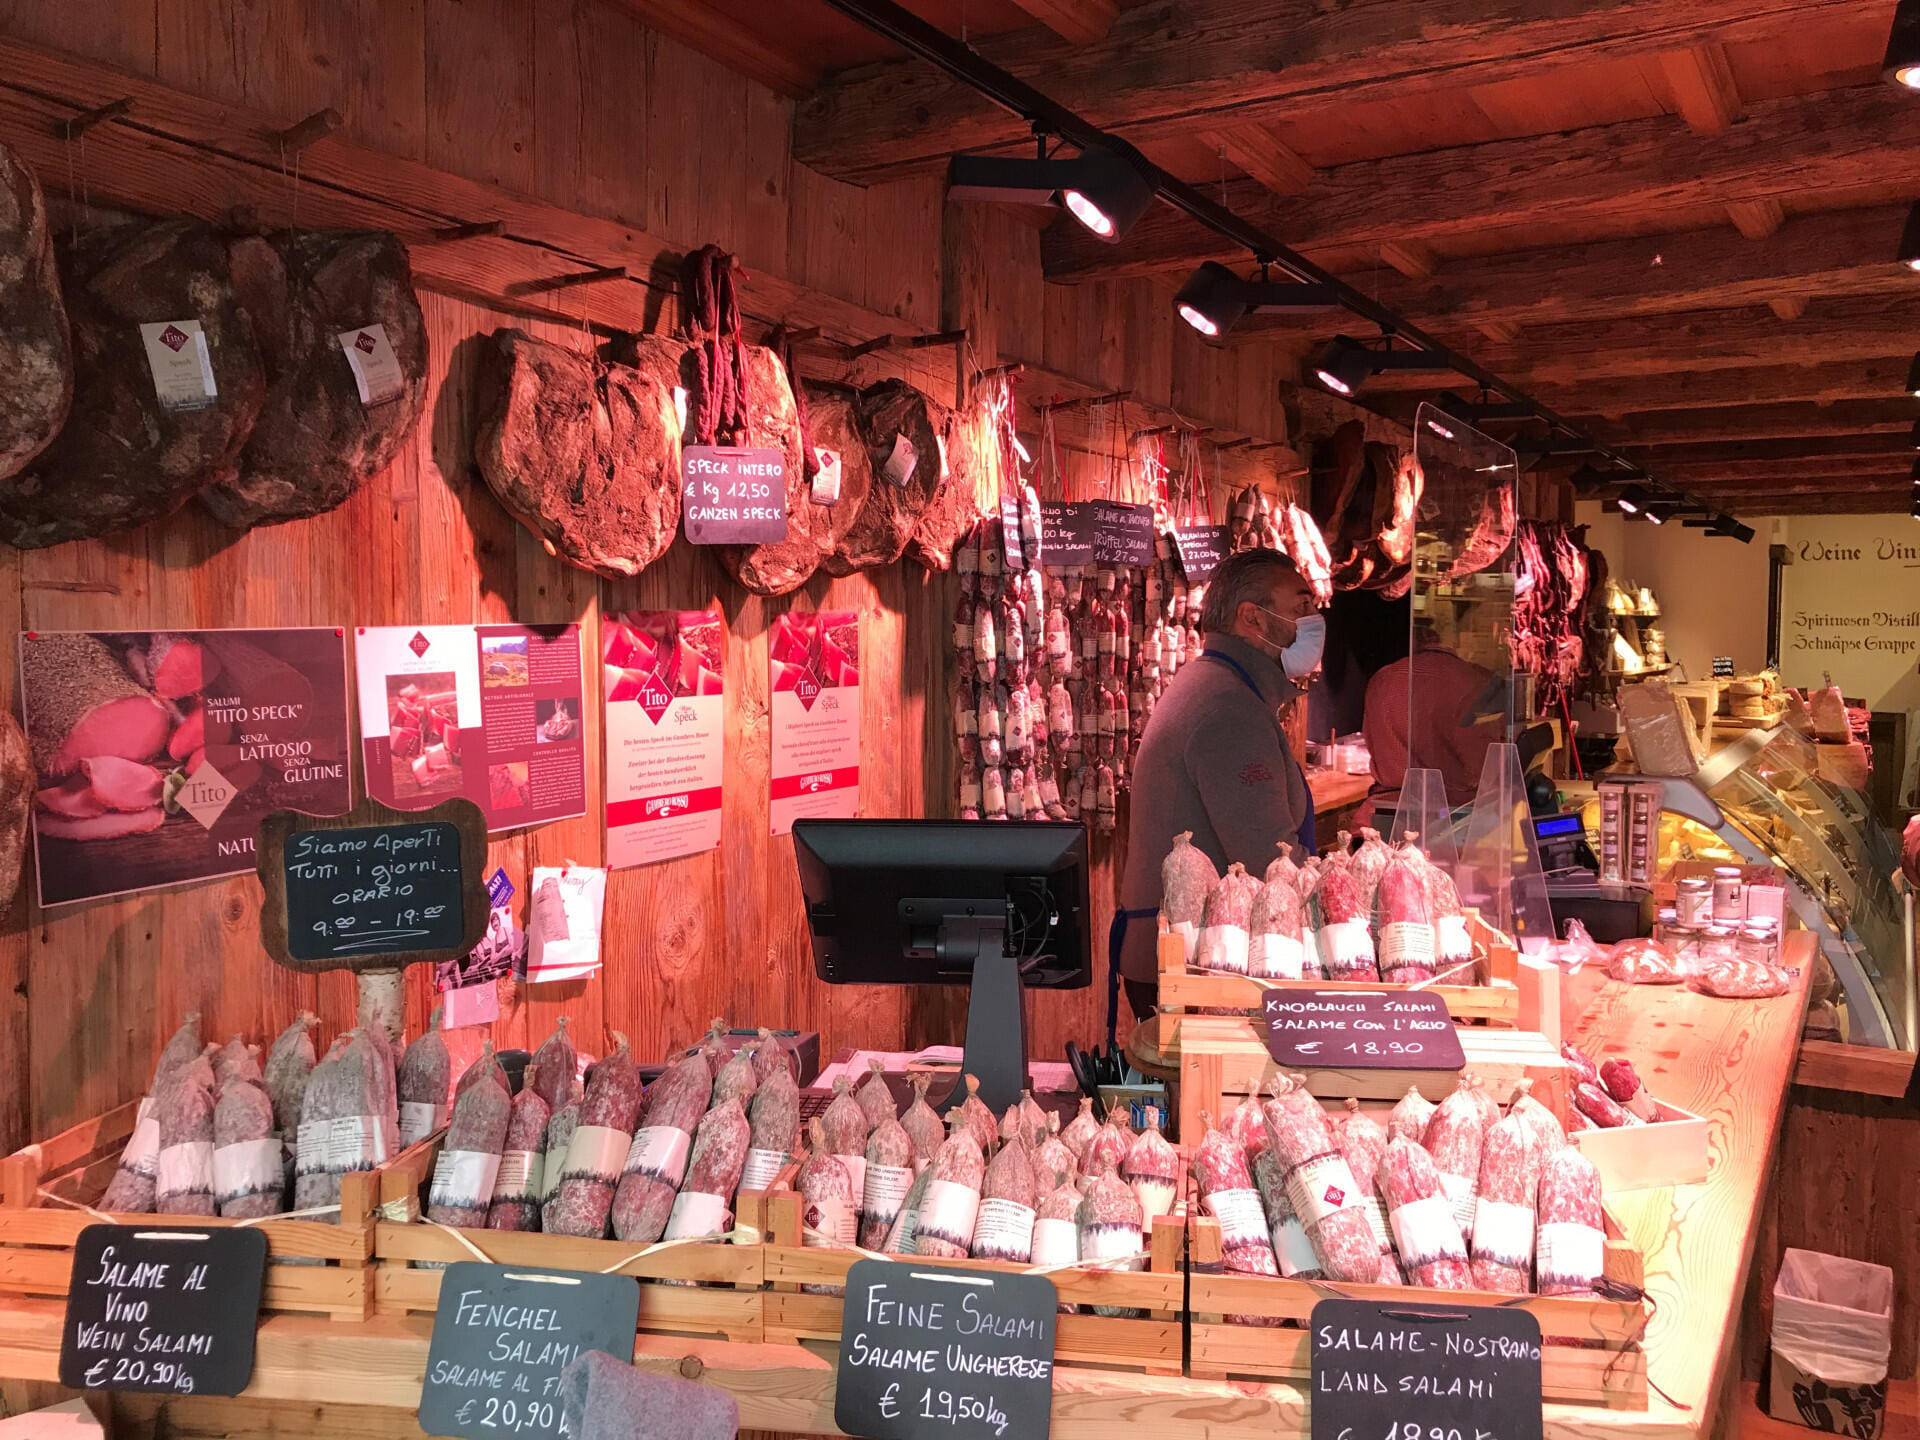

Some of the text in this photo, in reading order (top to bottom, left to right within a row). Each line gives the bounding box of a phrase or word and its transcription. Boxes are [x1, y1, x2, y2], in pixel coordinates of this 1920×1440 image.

[687, 460, 729, 474] SPECK
[684, 482, 696, 497] €
[727, 482, 770, 501] 12,50
[688, 506, 781, 521] GANZEN SPECK
[1797, 540, 1862, 562] Weine
[1792, 611, 1870, 630] Spirituosen
[1791, 633, 1916, 654] Schnäpse Grappe
[642, 688, 668, 706] Tito
[799, 680, 817, 696] Tito
[207, 697, 241, 708] SALUMI
[674, 709, 698, 725] Speck
[240, 733, 269, 744] SENZA
[239, 741, 312, 761] LATTOSIO
[283, 757, 311, 767] SENZA
[284, 764, 344, 783] GLUTINE
[187, 782, 226, 804] Tito
[294, 835, 367, 858] Siamo
[332, 884, 414, 905] ORARIO
[1265, 1000, 1436, 1013] KNOBLAUCH SALAMI
[1272, 1019, 1347, 1031] SALAME
[1294, 1042, 1324, 1055] €
[87, 1245, 209, 1290] SALAME AL
[104, 1291, 149, 1323] VINO
[455, 1289, 562, 1331] FENCHEL
[866, 1284, 1045, 1340] FEINE SALAMI
[77, 1321, 214, 1356] WEIN SALAMI
[849, 1332, 1052, 1379] SALAME UNGHERESE
[84, 1358, 109, 1387] €
[430, 1360, 507, 1389] SALAME
[512, 1372, 530, 1393] AL
[1320, 1370, 1499, 1399] LAND SALAMI
[878, 1382, 901, 1419] €
[455, 1399, 478, 1426] €
[480, 1397, 554, 1432] 20,90
